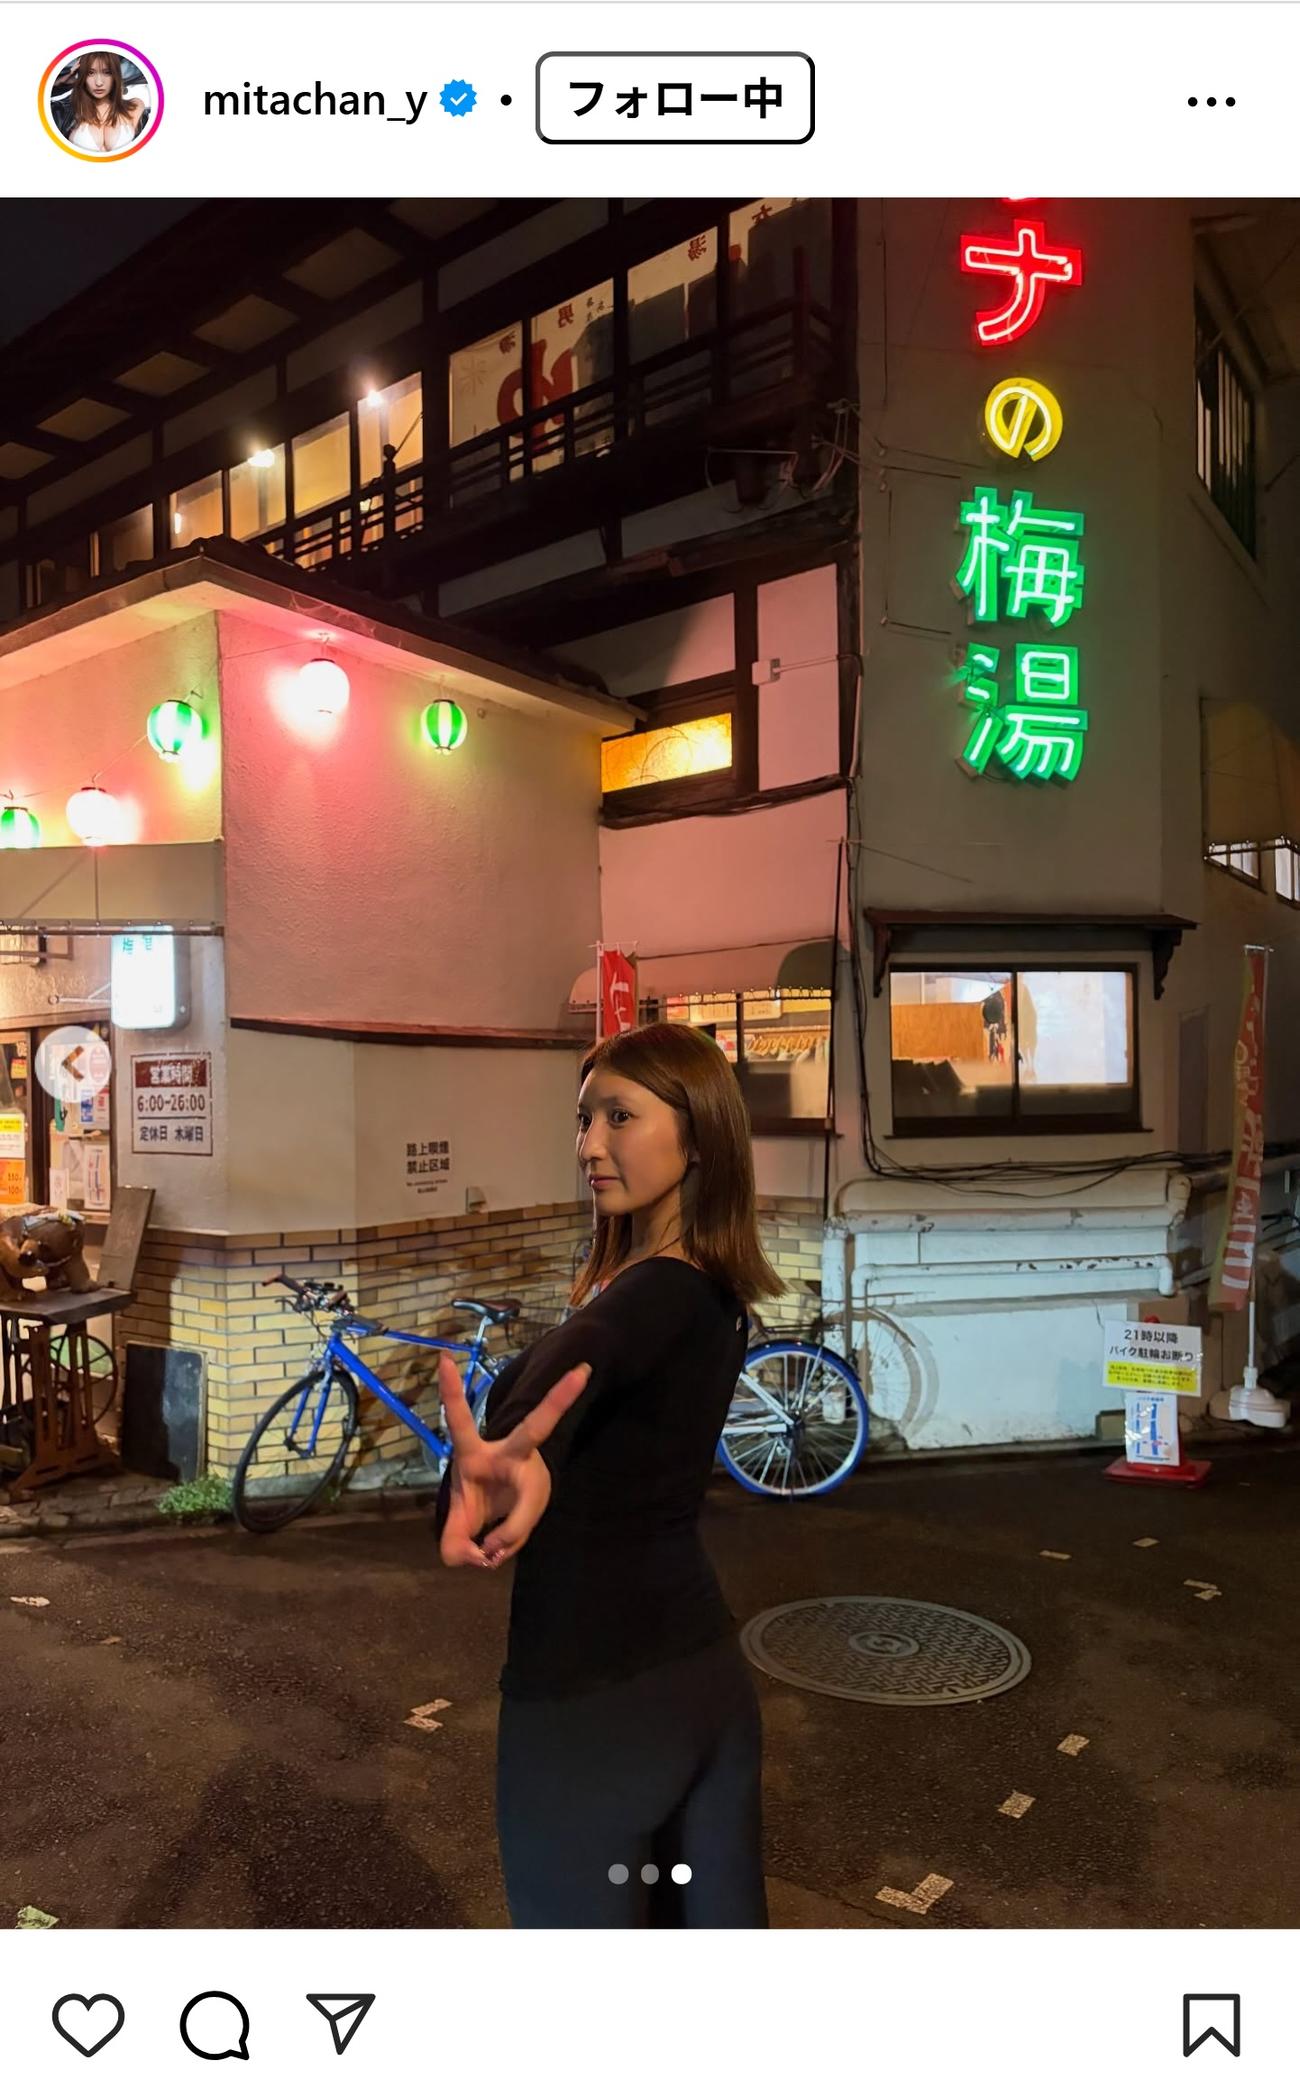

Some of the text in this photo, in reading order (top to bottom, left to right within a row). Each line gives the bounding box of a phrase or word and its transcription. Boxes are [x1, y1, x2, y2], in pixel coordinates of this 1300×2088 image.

[957, 198, 1088, 782] ナの梅湯
[140, 1125, 204, 1142] 定休日 木曜日
[407, 1157, 450, 1175] 禁止区域
[1124, 1328, 1179, 1344] 21時以降
[1109, 1345, 1194, 1362] バイク駐輪お断り
